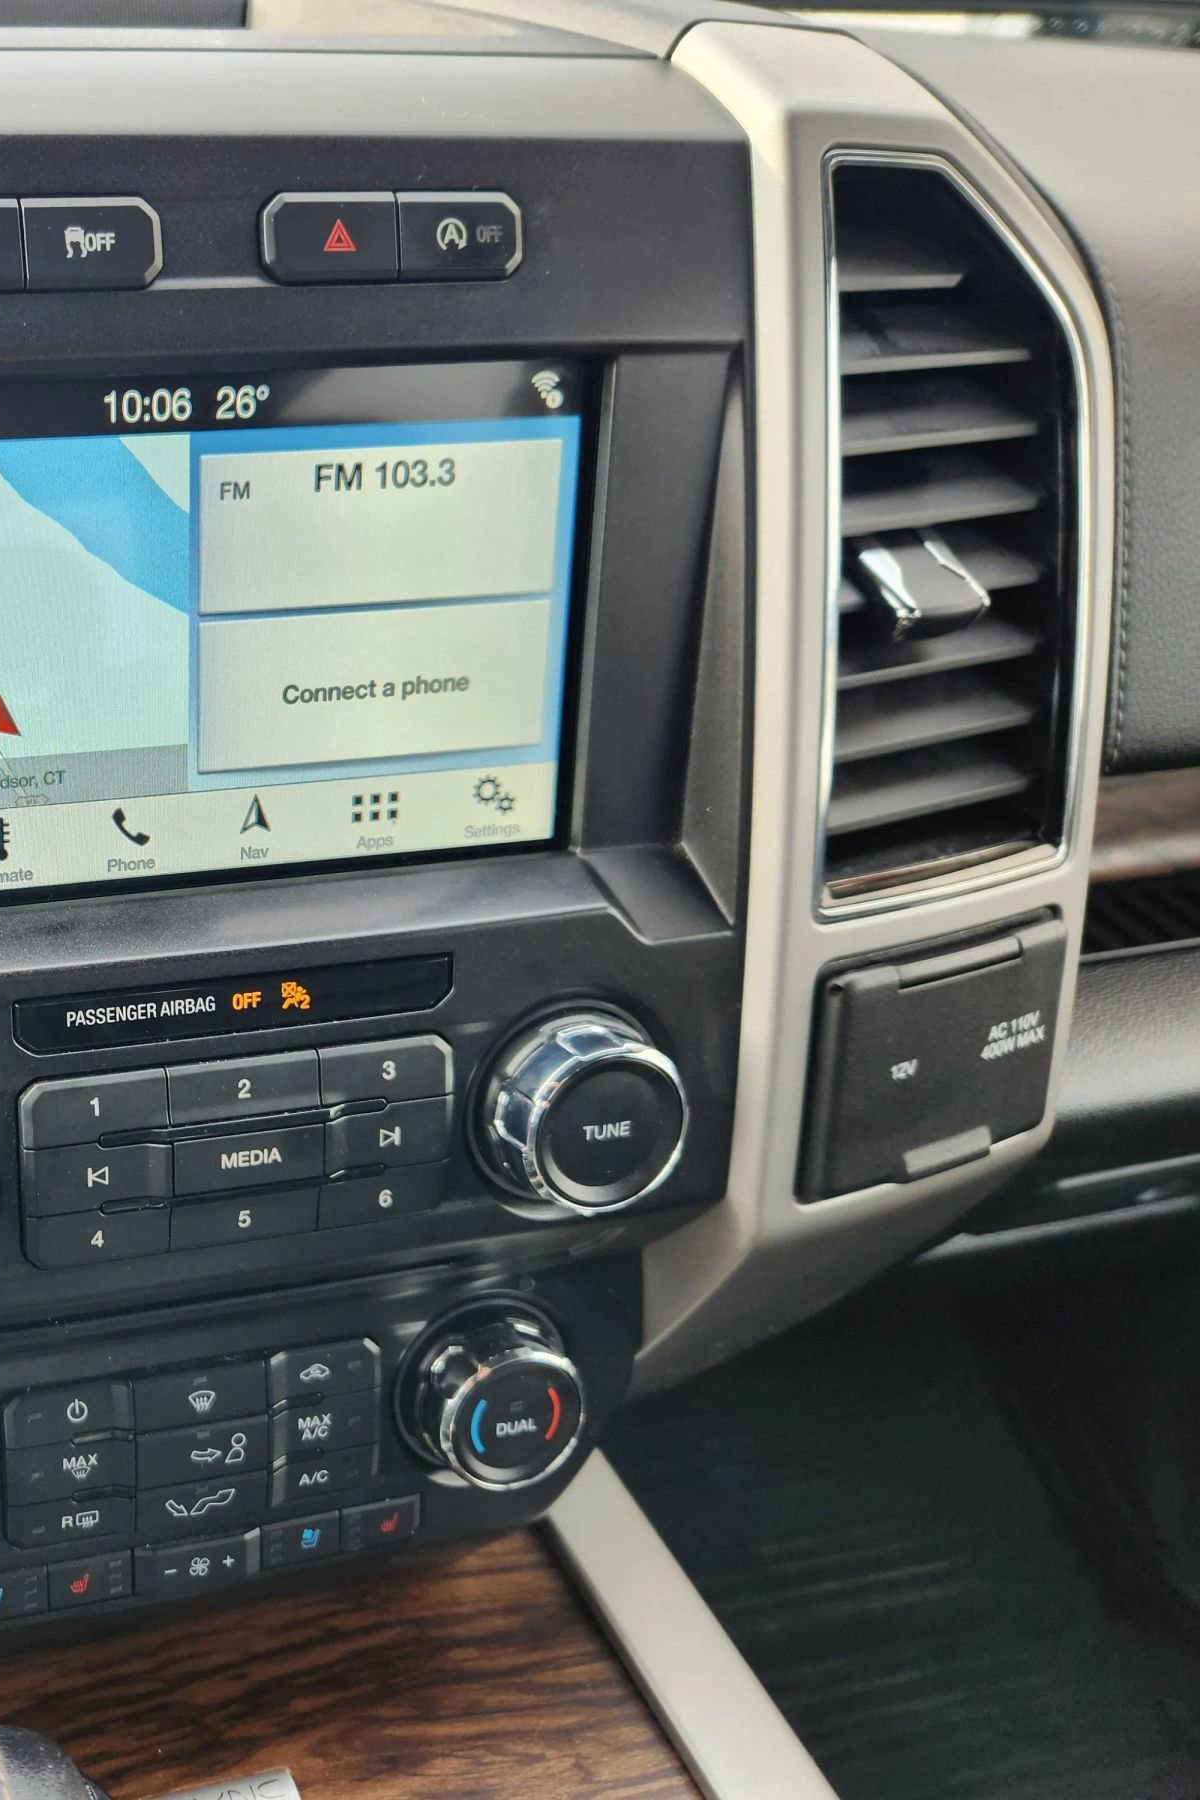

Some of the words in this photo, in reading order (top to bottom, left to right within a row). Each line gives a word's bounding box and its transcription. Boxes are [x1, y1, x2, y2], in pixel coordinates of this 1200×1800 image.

[84, 232, 115, 252] OFF
[476, 225, 504, 243] OFF
[103, 387, 193, 424] 10:06
[215, 384, 270, 420] 26°
[313, 462, 363, 493] FM
[374, 458, 457, 490] 103.3
[219, 481, 251, 501] FM
[282, 678, 377, 705] Connect
[382, 682, 396, 698] a
[401, 674, 470, 702] phone
[43, 770, 67, 786] CT
[464, 821, 521, 840] Settings
[356, 834, 394, 851] Apps
[240, 845, 270, 861] Nav
[107, 856, 156, 873] Phone
[66, 1002, 158, 1028] PASSENGER
[160, 995, 217, 1018] AIRBAG
[232, 991, 262, 1011] OFF
[987, 1021, 1008, 1042] AC
[1010, 1009, 1041, 1034] 110V
[1016, 1024, 1046, 1050] MAX
[381, 1060, 397, 1080] 3
[889, 1058, 920, 1081] 12V
[237, 1078, 252, 1099] 2
[89, 1097, 101, 1117] 1
[582, 1120, 632, 1141] TUNE
[220, 1147, 283, 1170] MEDIA
[377, 1189, 394, 1208] 6
[237, 1210, 252, 1228] 5
[90, 1230, 105, 1248] 4
[298, 1413, 333, 1430] MAX
[495, 1417, 538, 1437] DUAL
[301, 1425, 330, 1441] A/C
[62, 1453, 99, 1470] MAX
[298, 1469, 330, 1487] A/C
[60, 1515, 74, 1529] R
